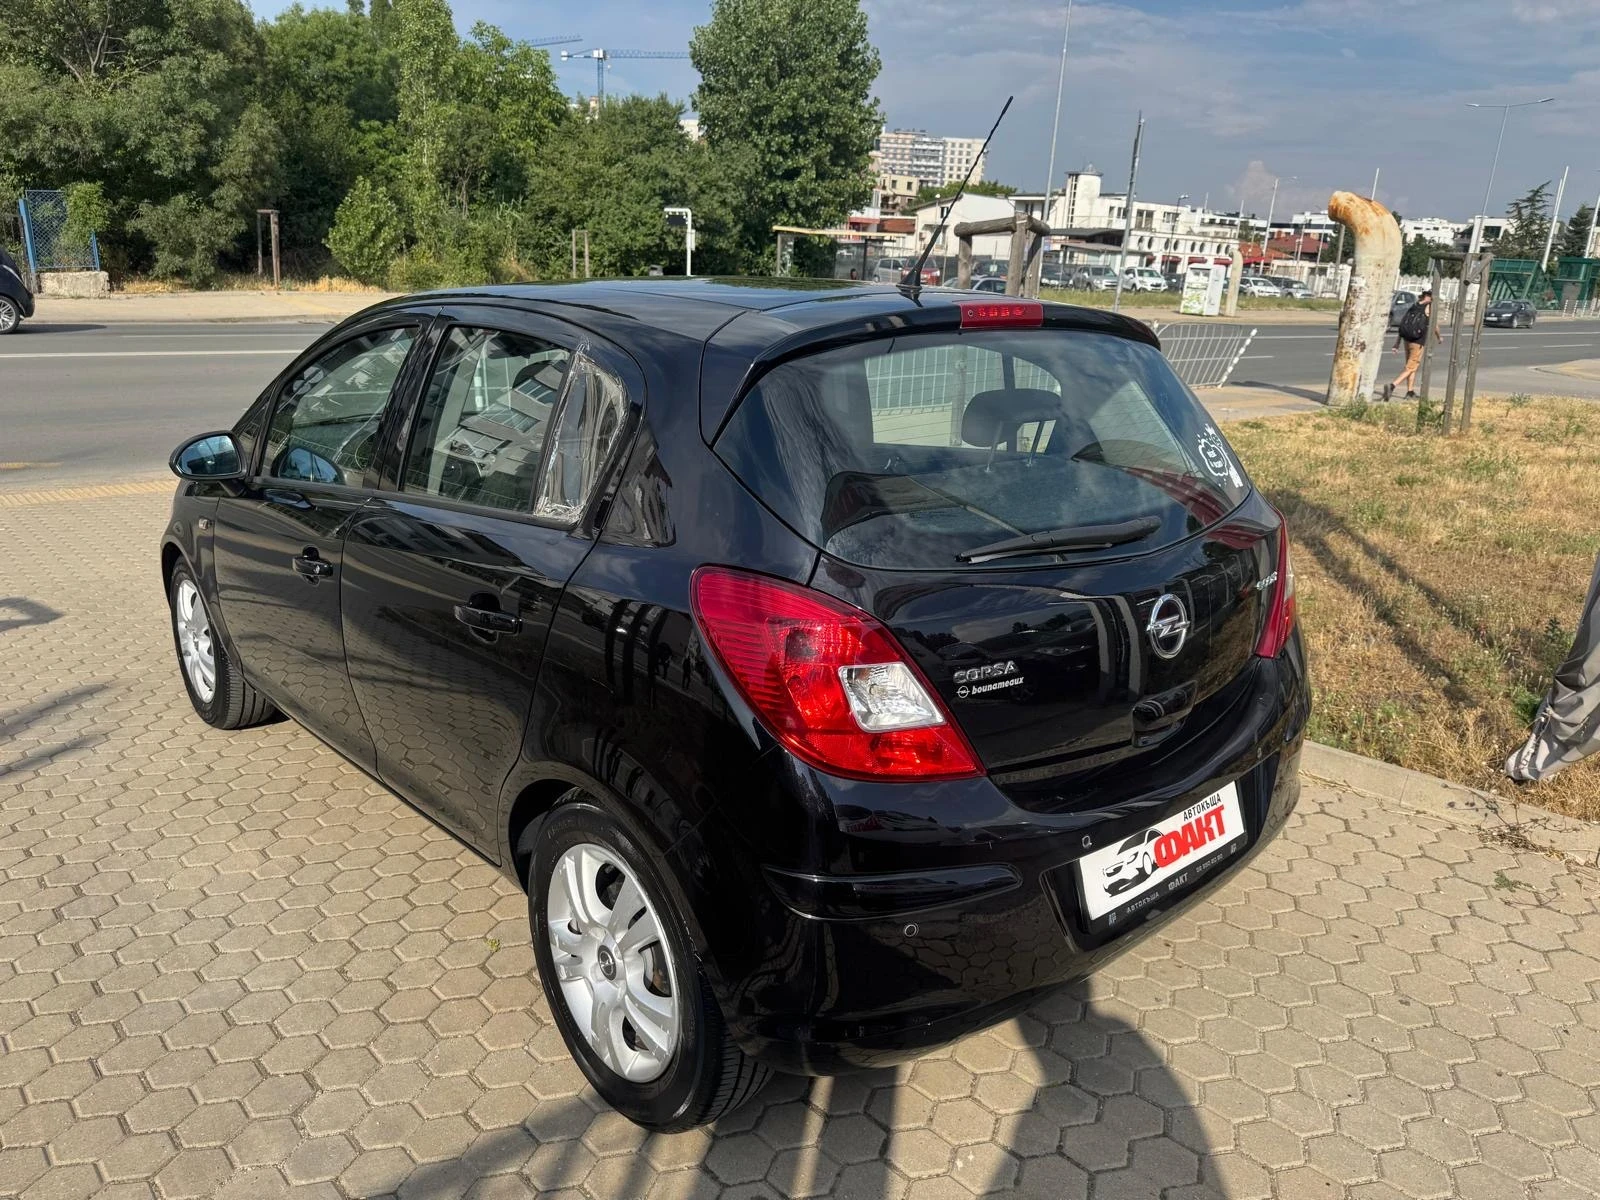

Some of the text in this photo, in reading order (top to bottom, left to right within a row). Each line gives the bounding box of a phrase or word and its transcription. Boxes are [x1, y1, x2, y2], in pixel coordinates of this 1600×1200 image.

[953, 660, 1018, 683] CORSA
[971, 676, 1024, 695] bounameaux
[1183, 793, 1222, 822] АВТОКЪЩА
[1153, 804, 1225, 868] ФАКТ
[1168, 872, 1189, 891] ФАКТ
